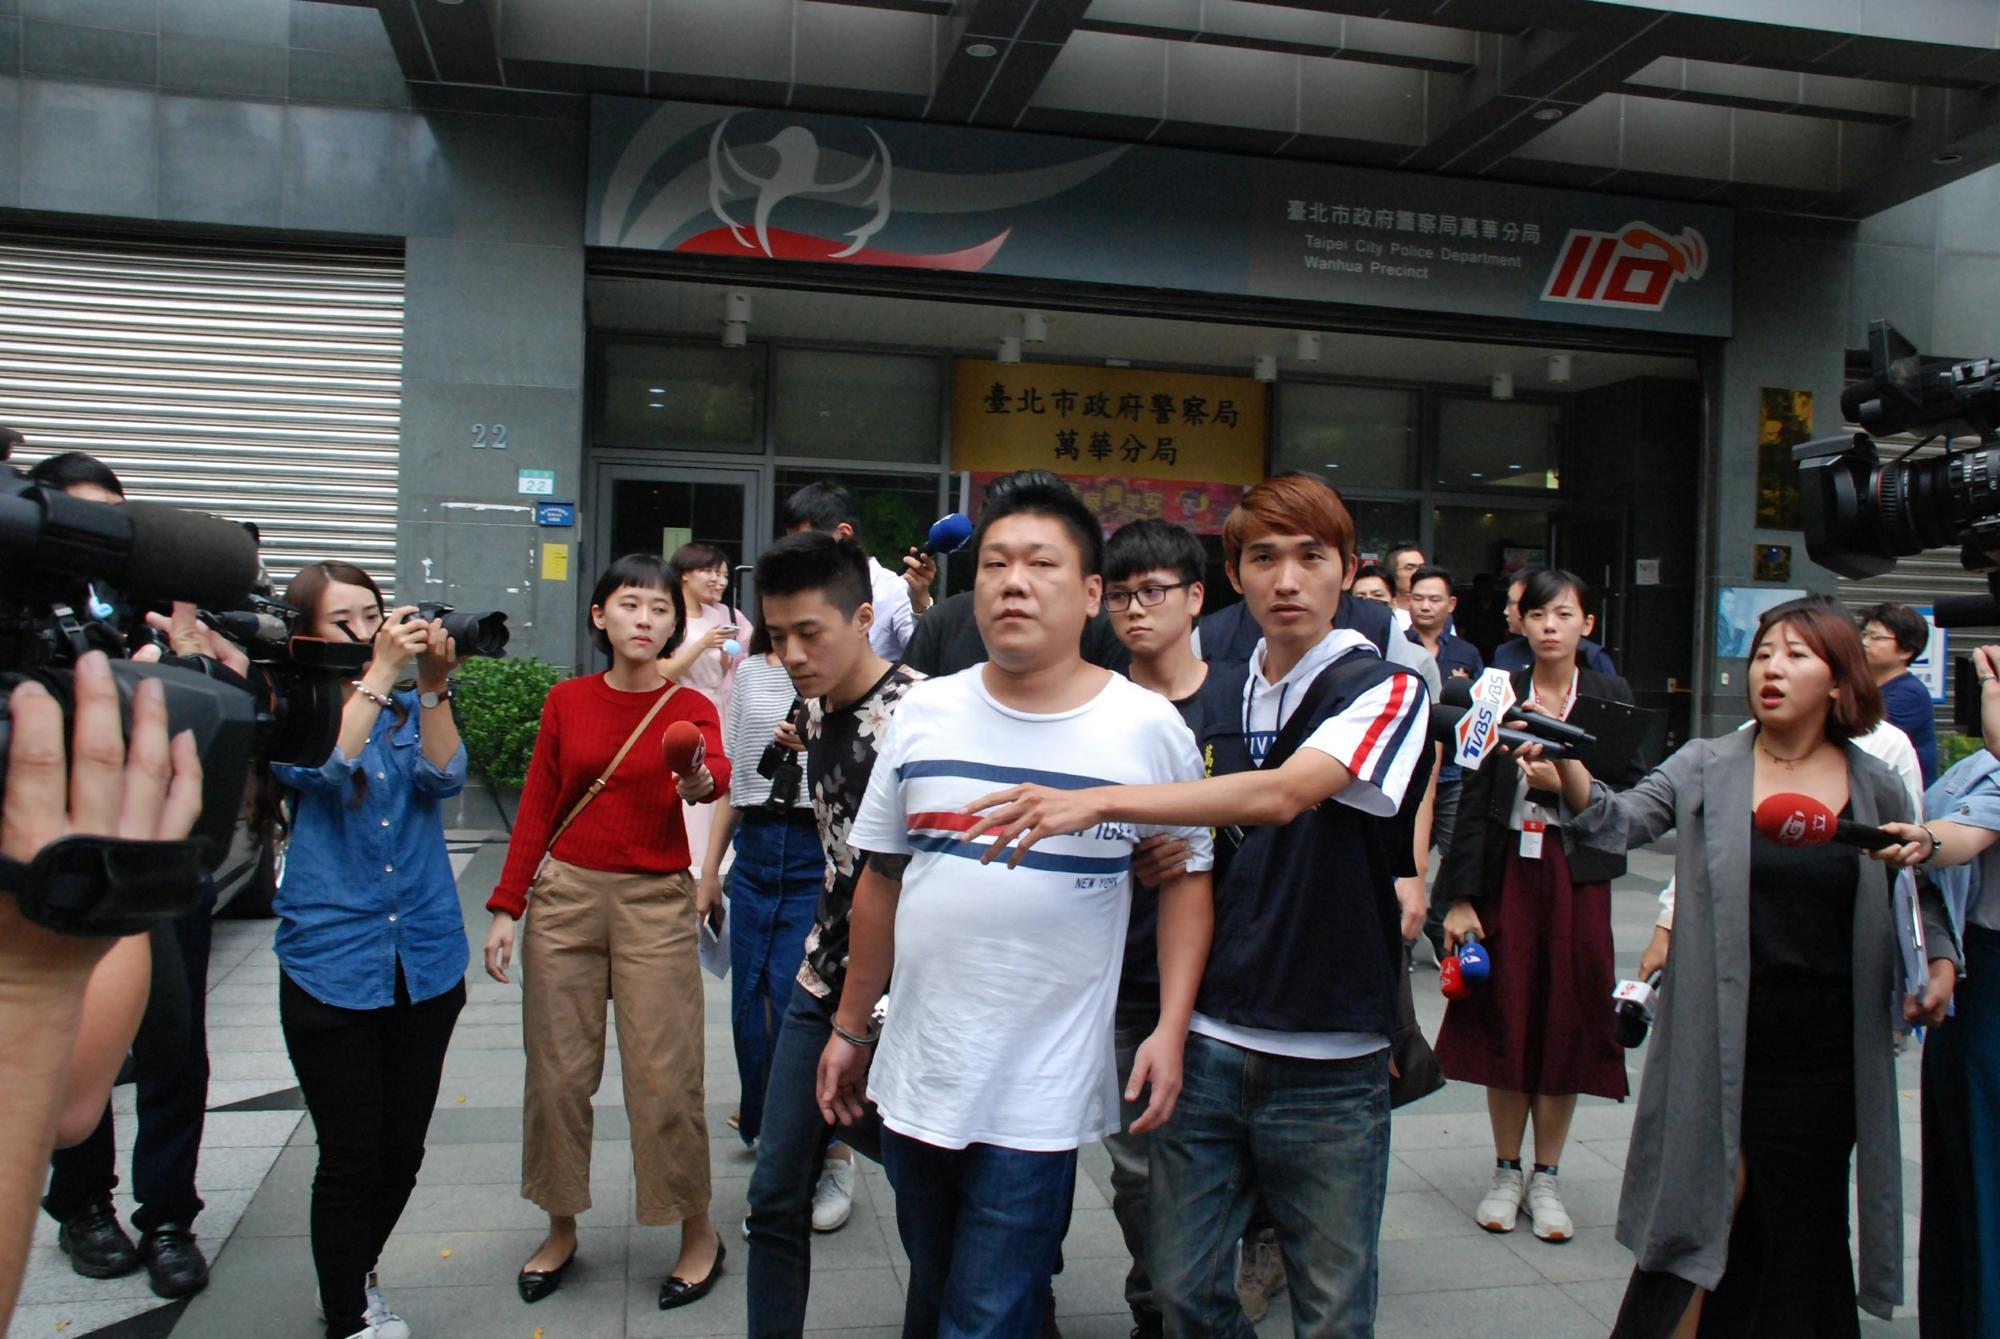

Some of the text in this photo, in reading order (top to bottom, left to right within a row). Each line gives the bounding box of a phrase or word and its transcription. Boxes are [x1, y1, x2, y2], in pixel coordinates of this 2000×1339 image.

[1287, 200, 1541, 245] 臺北市政府警察局萬華分局
[1304, 255, 1429, 280] Wanhua Precinct
[1305, 234, 1521, 269] Taipei City Police Department
[983, 381, 1240, 429] 臺北市政府警察局
[471, 423, 507, 450] 22
[1053, 427, 1178, 467] 萬華分局
[525, 480, 547, 492] 22
[1484, 675, 1504, 706] VBS
[1463, 707, 1494, 760] TVBS
[1074, 877, 1096, 889] NEW
